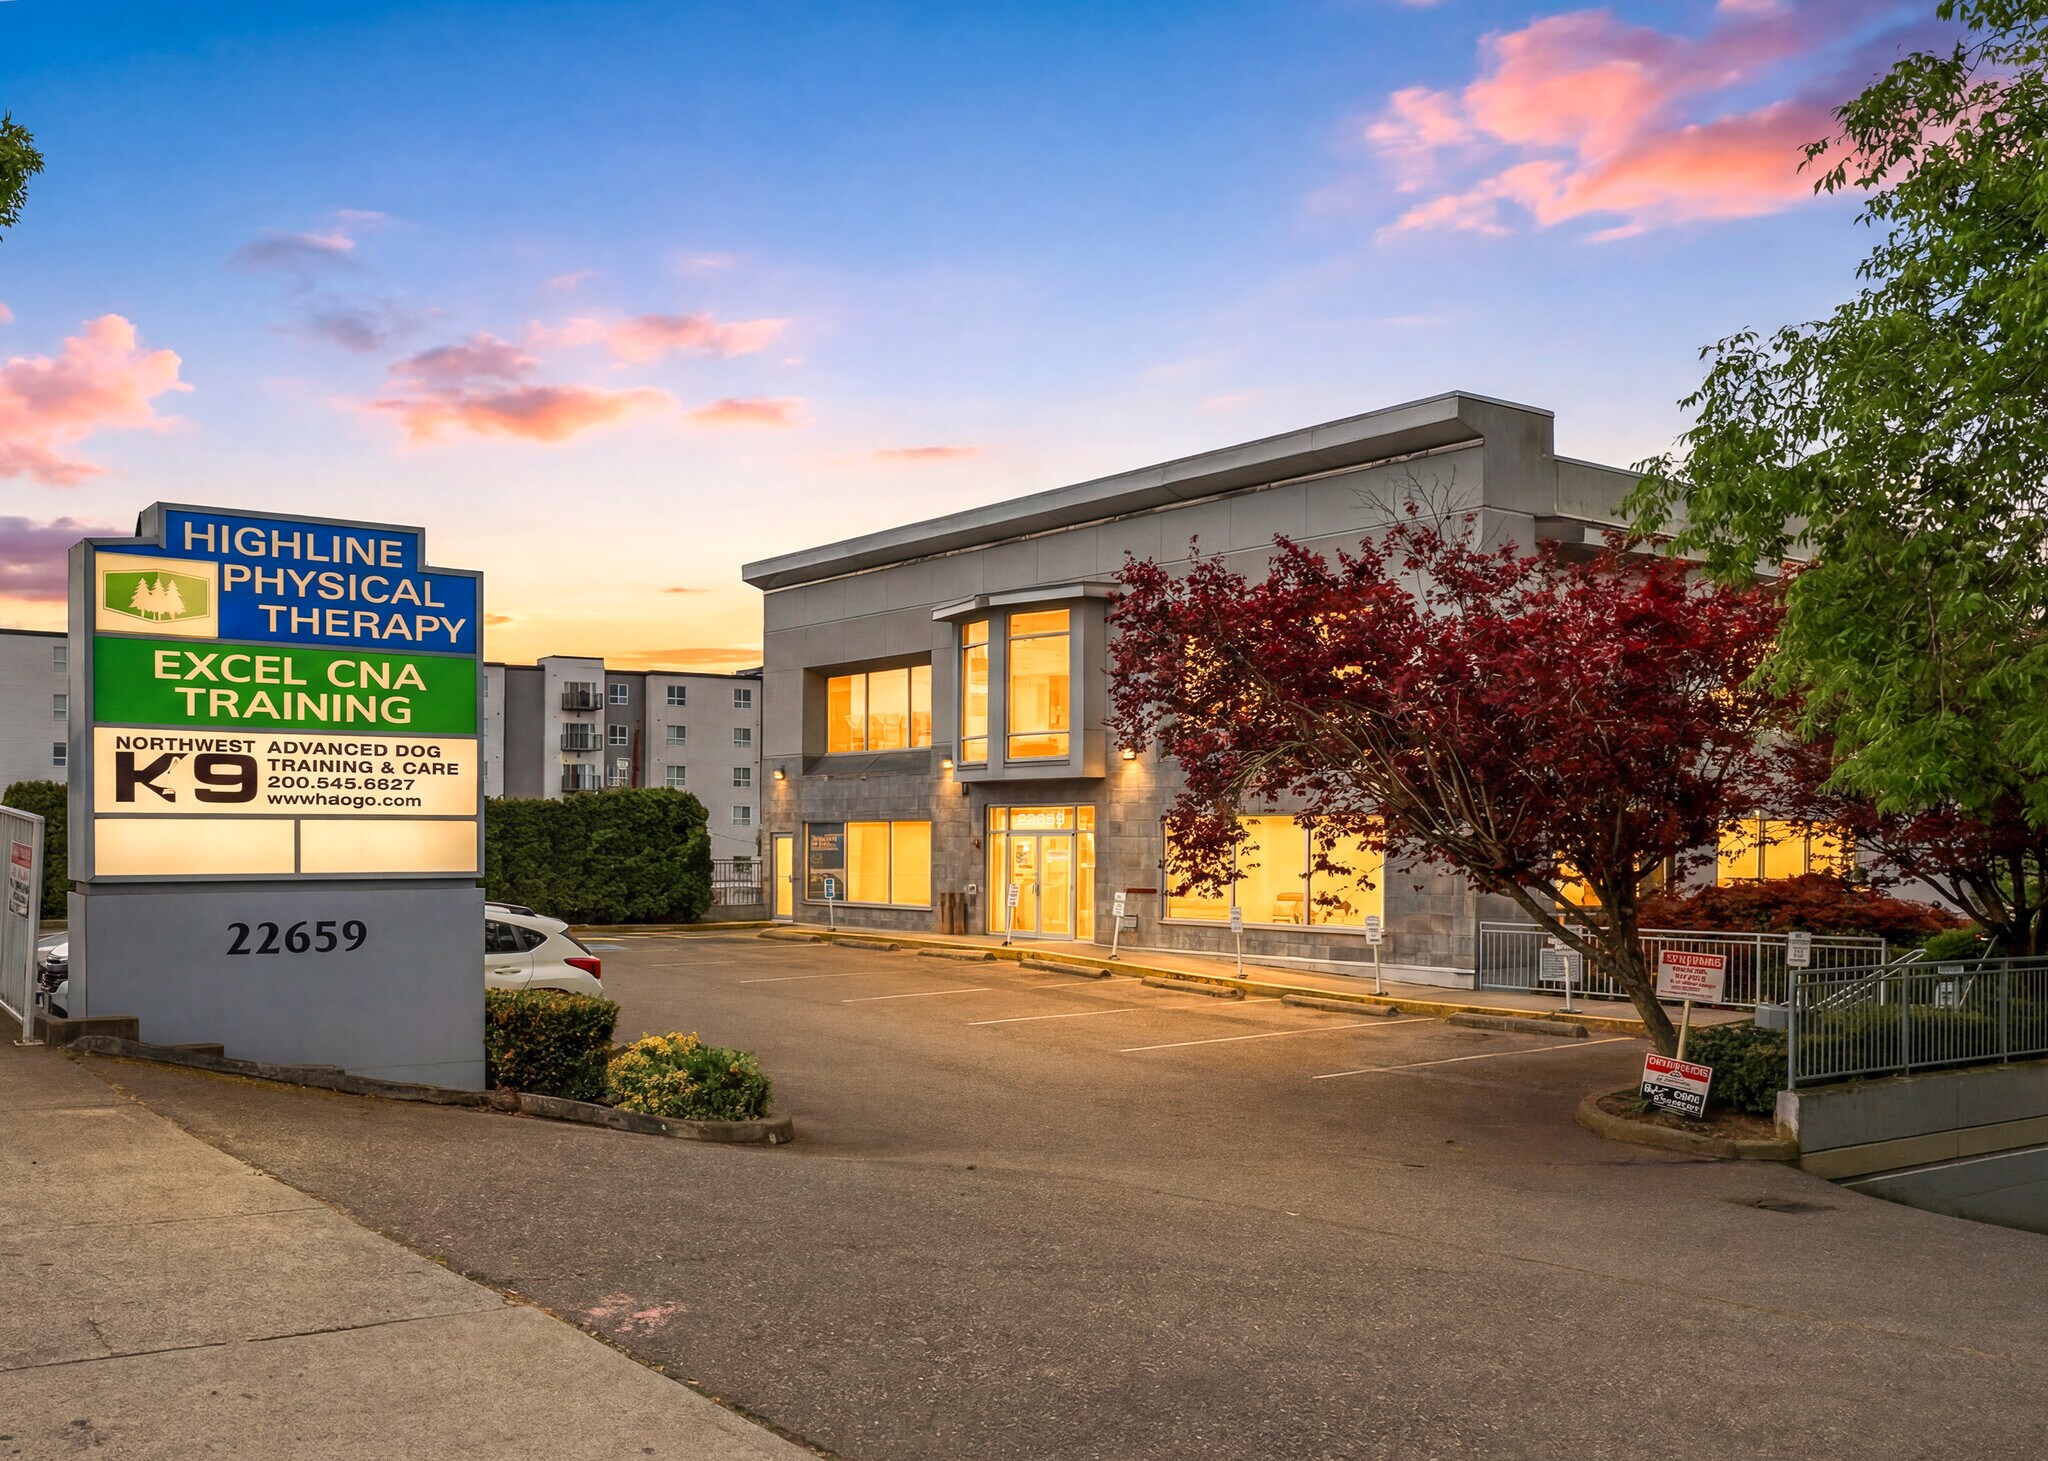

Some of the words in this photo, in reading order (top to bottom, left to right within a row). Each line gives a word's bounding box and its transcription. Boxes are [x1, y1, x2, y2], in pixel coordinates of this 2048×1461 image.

[184, 521, 403, 568] HIGHLINE
[223, 563, 445, 608] PHYSICAL
[258, 604, 467, 644] THERAPY
[154, 649, 307, 686] EXCEL
[326, 659, 427, 691] CNA
[174, 686, 412, 724] TRAINING
[116, 736, 256, 753] NORTHWEST
[267, 741, 388, 757] ADVANCED
[395, 745, 441, 758] DOG
[115, 752, 258, 803] K9
[267, 758, 374, 774] TRAINING
[380, 762, 396, 774] &
[402, 762, 459, 775] CARE
[1018, 813, 1065, 825] 22659
[226, 919, 368, 955] 22659
